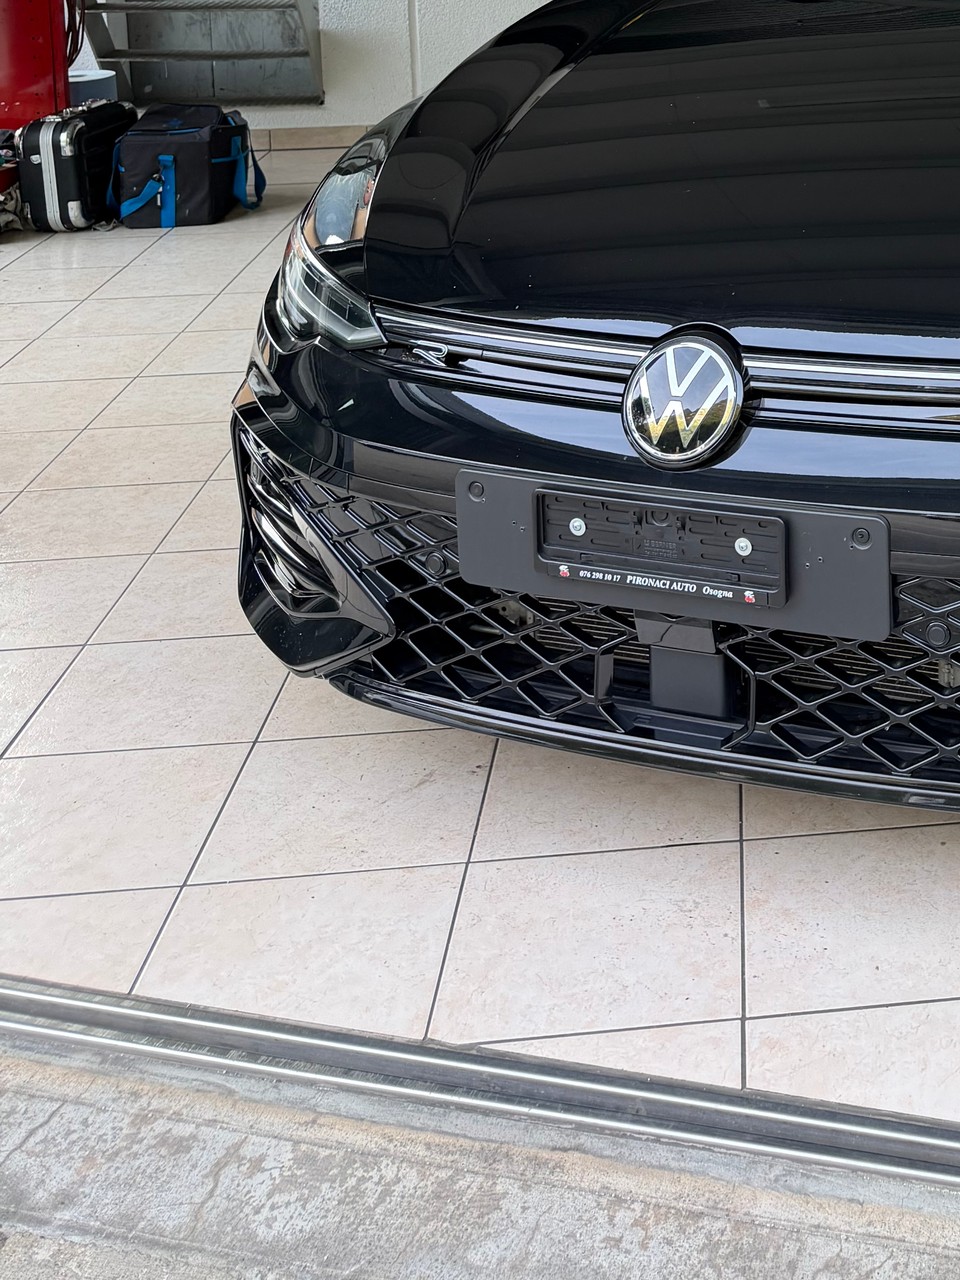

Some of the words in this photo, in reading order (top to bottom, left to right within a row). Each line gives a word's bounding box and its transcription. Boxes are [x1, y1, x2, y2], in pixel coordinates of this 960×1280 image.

[407, 339, 449, 367] R
[579, 570, 591, 578] 076
[591, 572, 603, 580] 298
[604, 573, 612, 581] 10
[626, 575, 671, 589] PIRONACI
[670, 582, 697, 593] AUTO
[702, 586, 734, 598] Osogna
